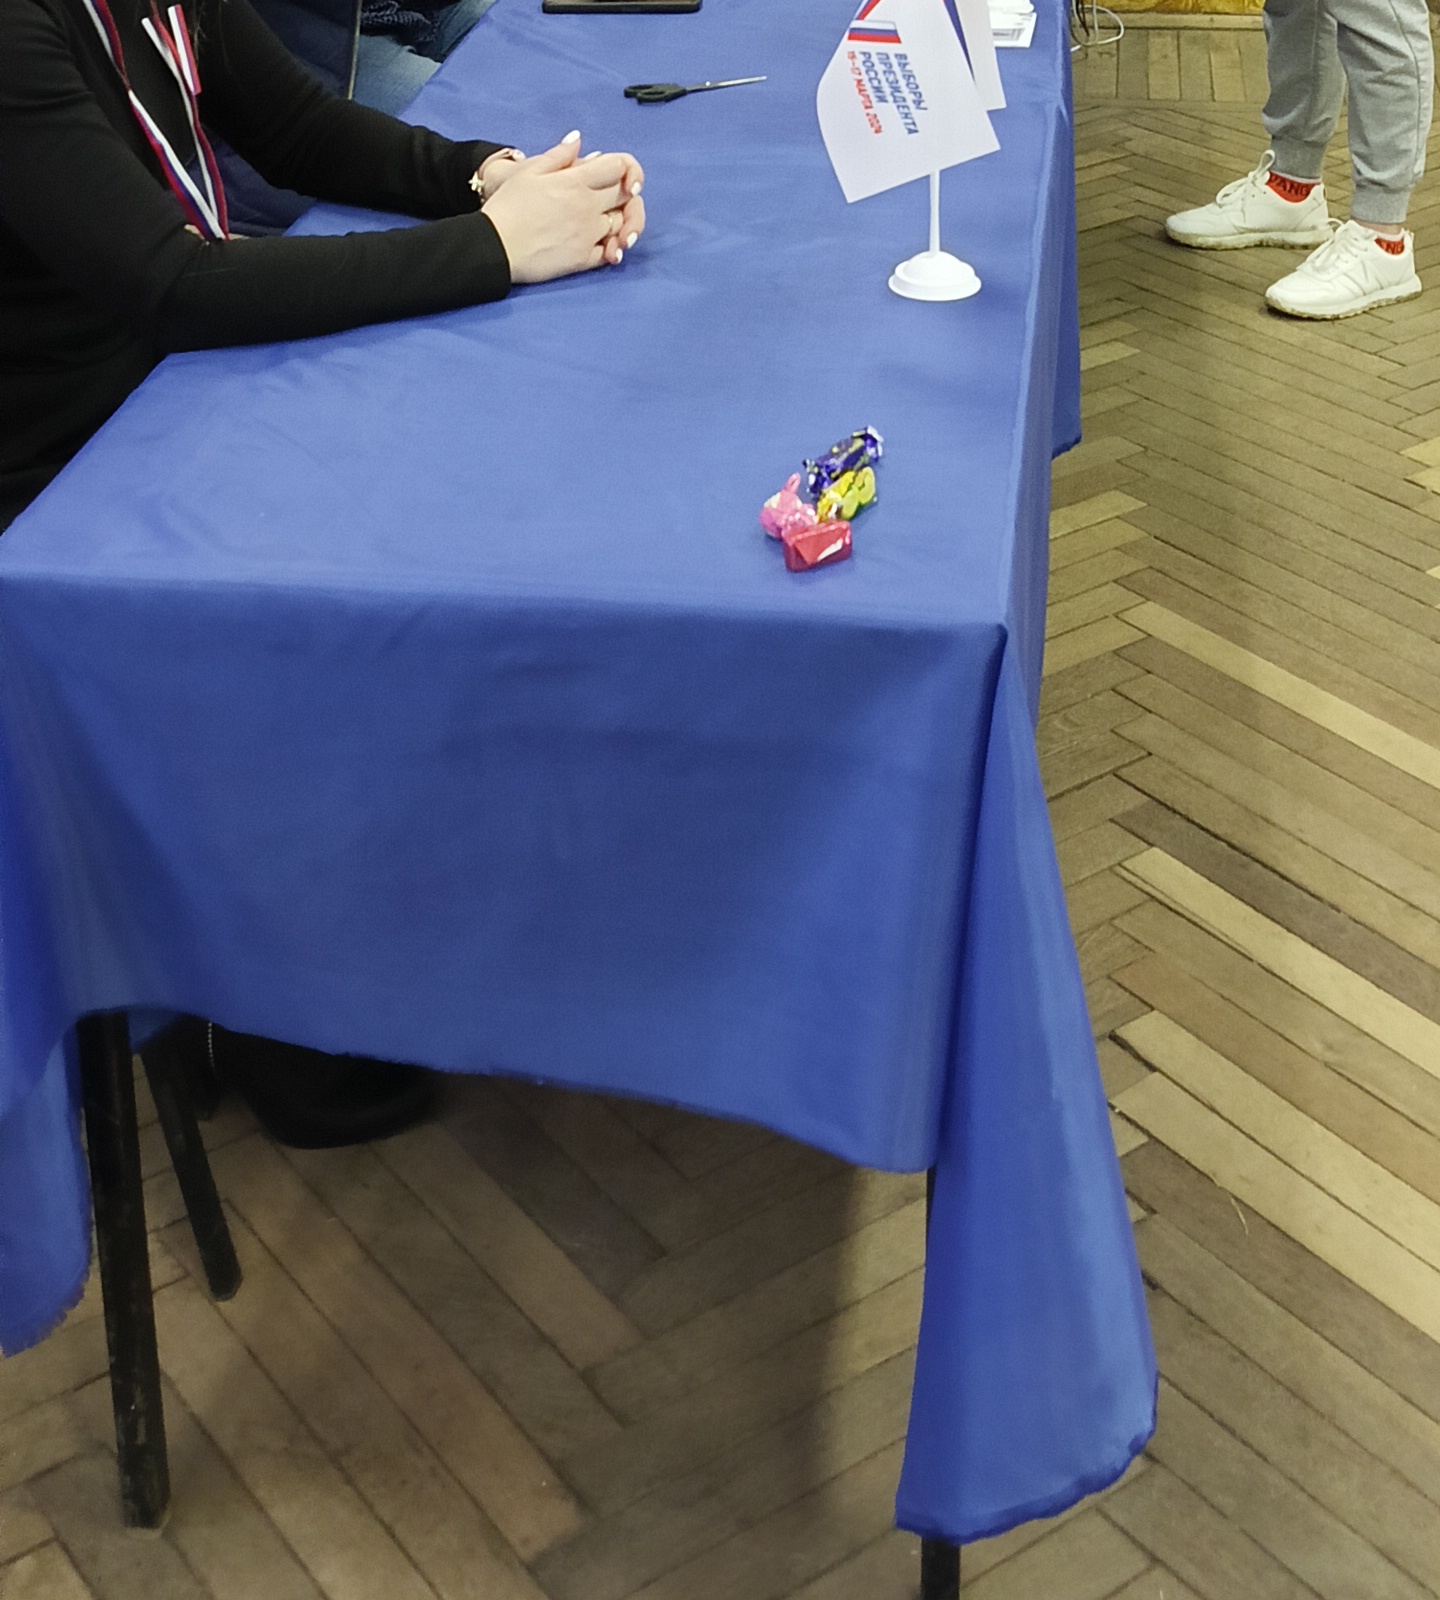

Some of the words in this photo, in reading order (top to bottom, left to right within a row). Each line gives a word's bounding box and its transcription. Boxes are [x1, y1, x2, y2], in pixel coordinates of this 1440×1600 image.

[859, 51, 889, 103] РОССИИ
[875, 51, 919, 135] ПРЕЗИДЕНТА
[893, 53, 928, 111] ВЫБОРЫ
[854, 78, 874, 110] МАРТА
[865, 112, 882, 134] 2024
